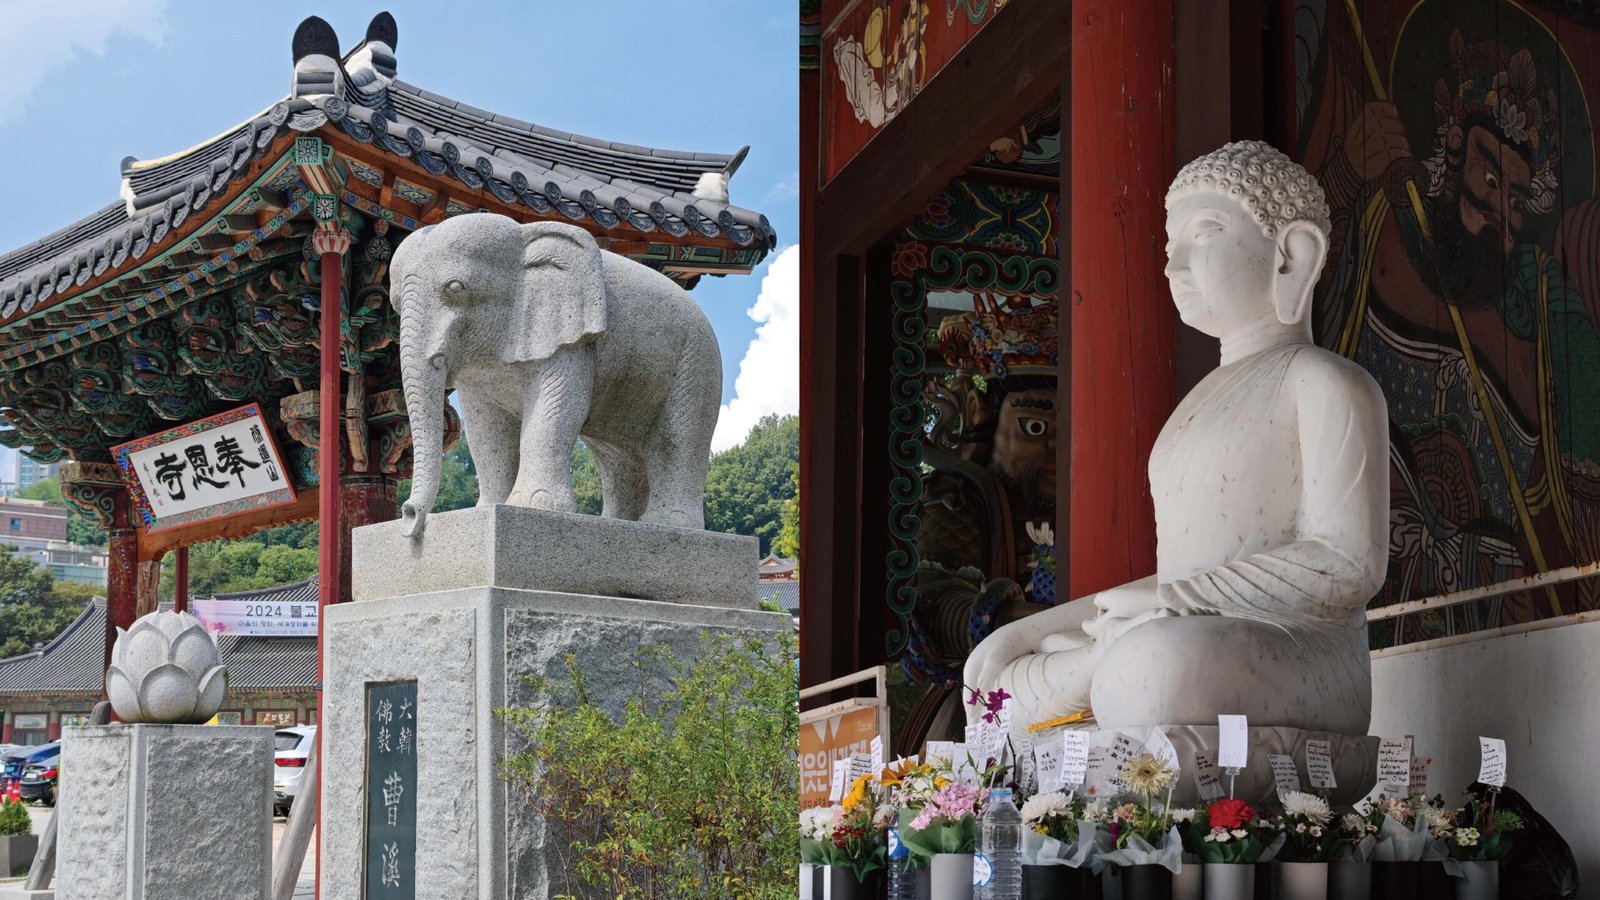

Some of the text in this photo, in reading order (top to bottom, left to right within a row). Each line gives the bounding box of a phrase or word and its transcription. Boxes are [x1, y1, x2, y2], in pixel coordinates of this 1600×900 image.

[154, 435, 262, 501] 奉恩寺
[246, 605, 282, 617] 2024
